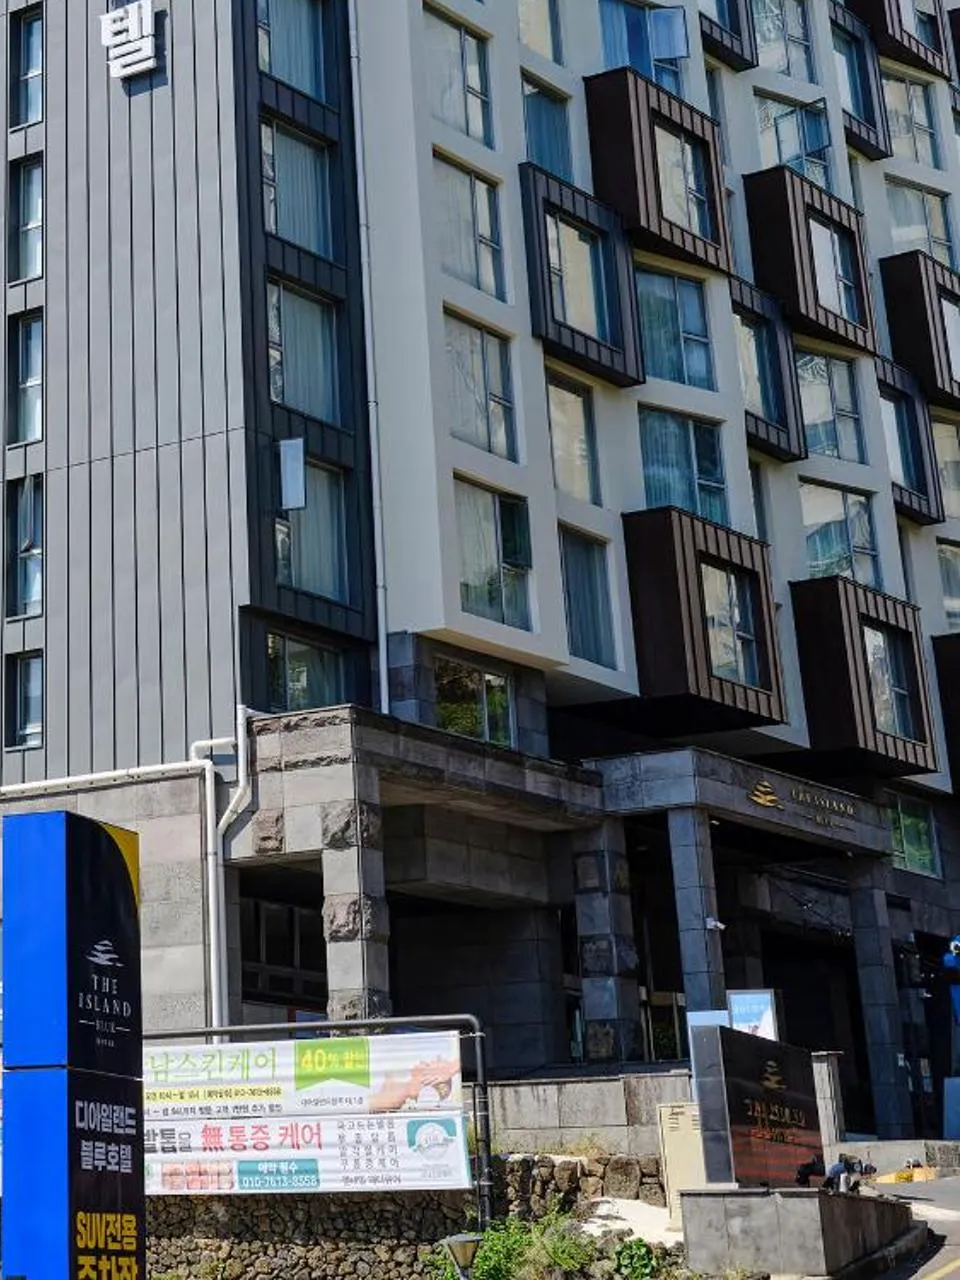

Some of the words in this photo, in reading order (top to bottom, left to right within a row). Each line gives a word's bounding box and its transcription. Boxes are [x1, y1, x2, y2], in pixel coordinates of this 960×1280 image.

[91, 973, 118, 995] THE
[78, 991, 132, 1017] ISLAND
[75, 1100, 136, 1136] 디아일랜드
[278, 1121, 323, 1151] 케어
[80, 1139, 133, 1174] 블루호텔
[76, 1211, 138, 1252] SUV전용
